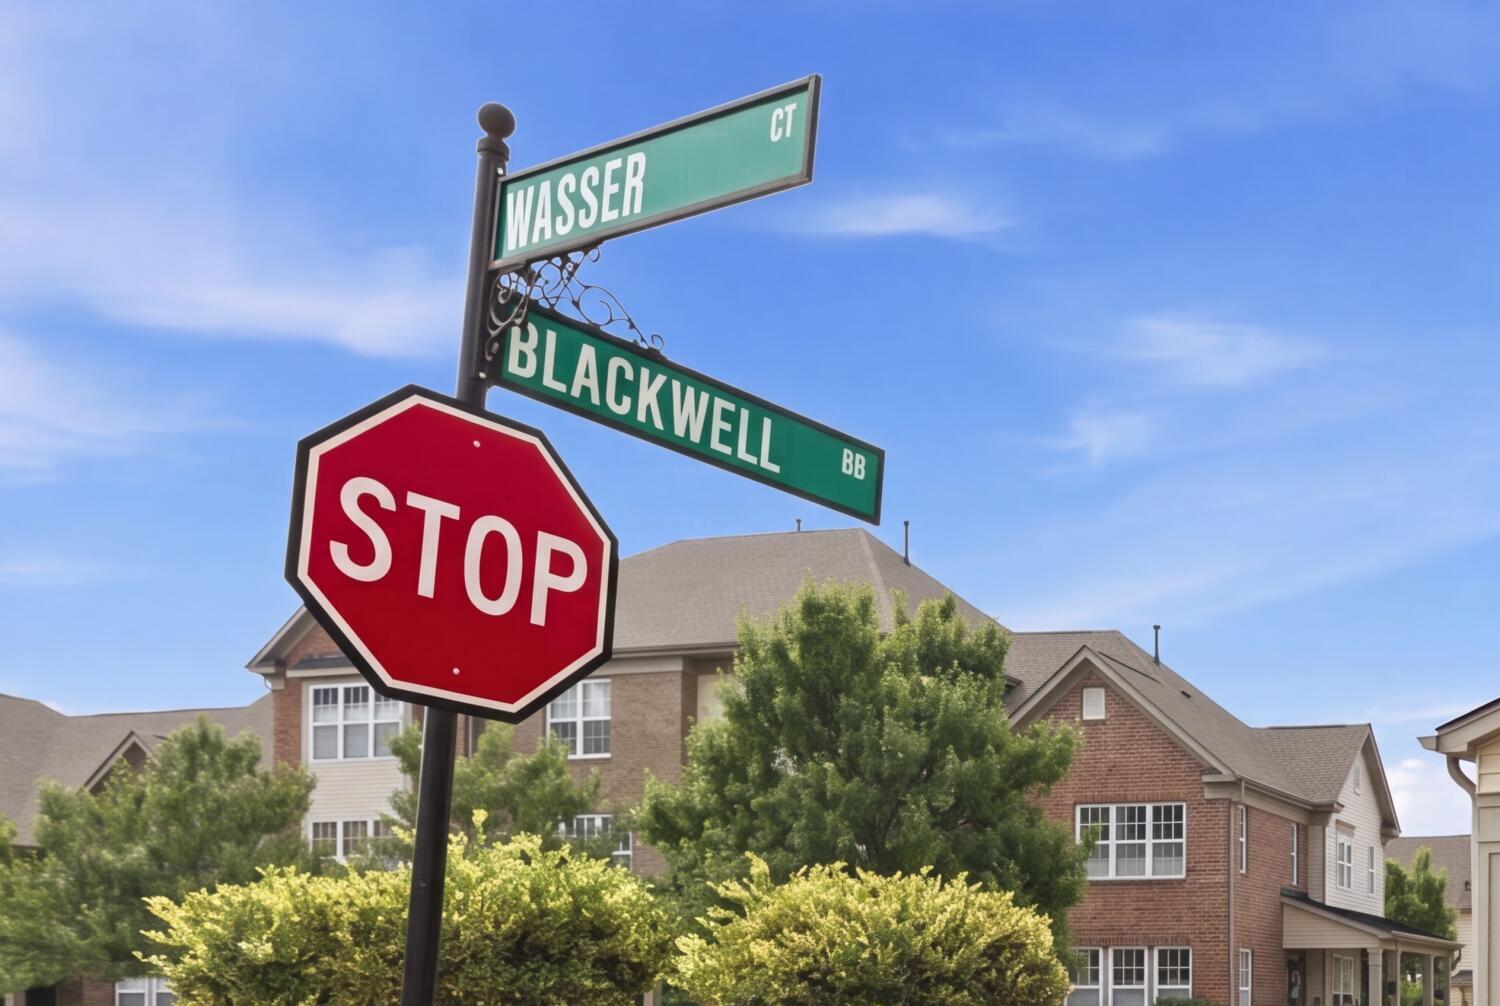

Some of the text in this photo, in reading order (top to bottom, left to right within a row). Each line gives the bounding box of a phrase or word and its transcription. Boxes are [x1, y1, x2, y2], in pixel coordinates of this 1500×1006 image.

[507, 103, 797, 251] WASSER CT
[507, 321, 866, 480] BLACKWELL BB
[329, 476, 588, 627] STOP
